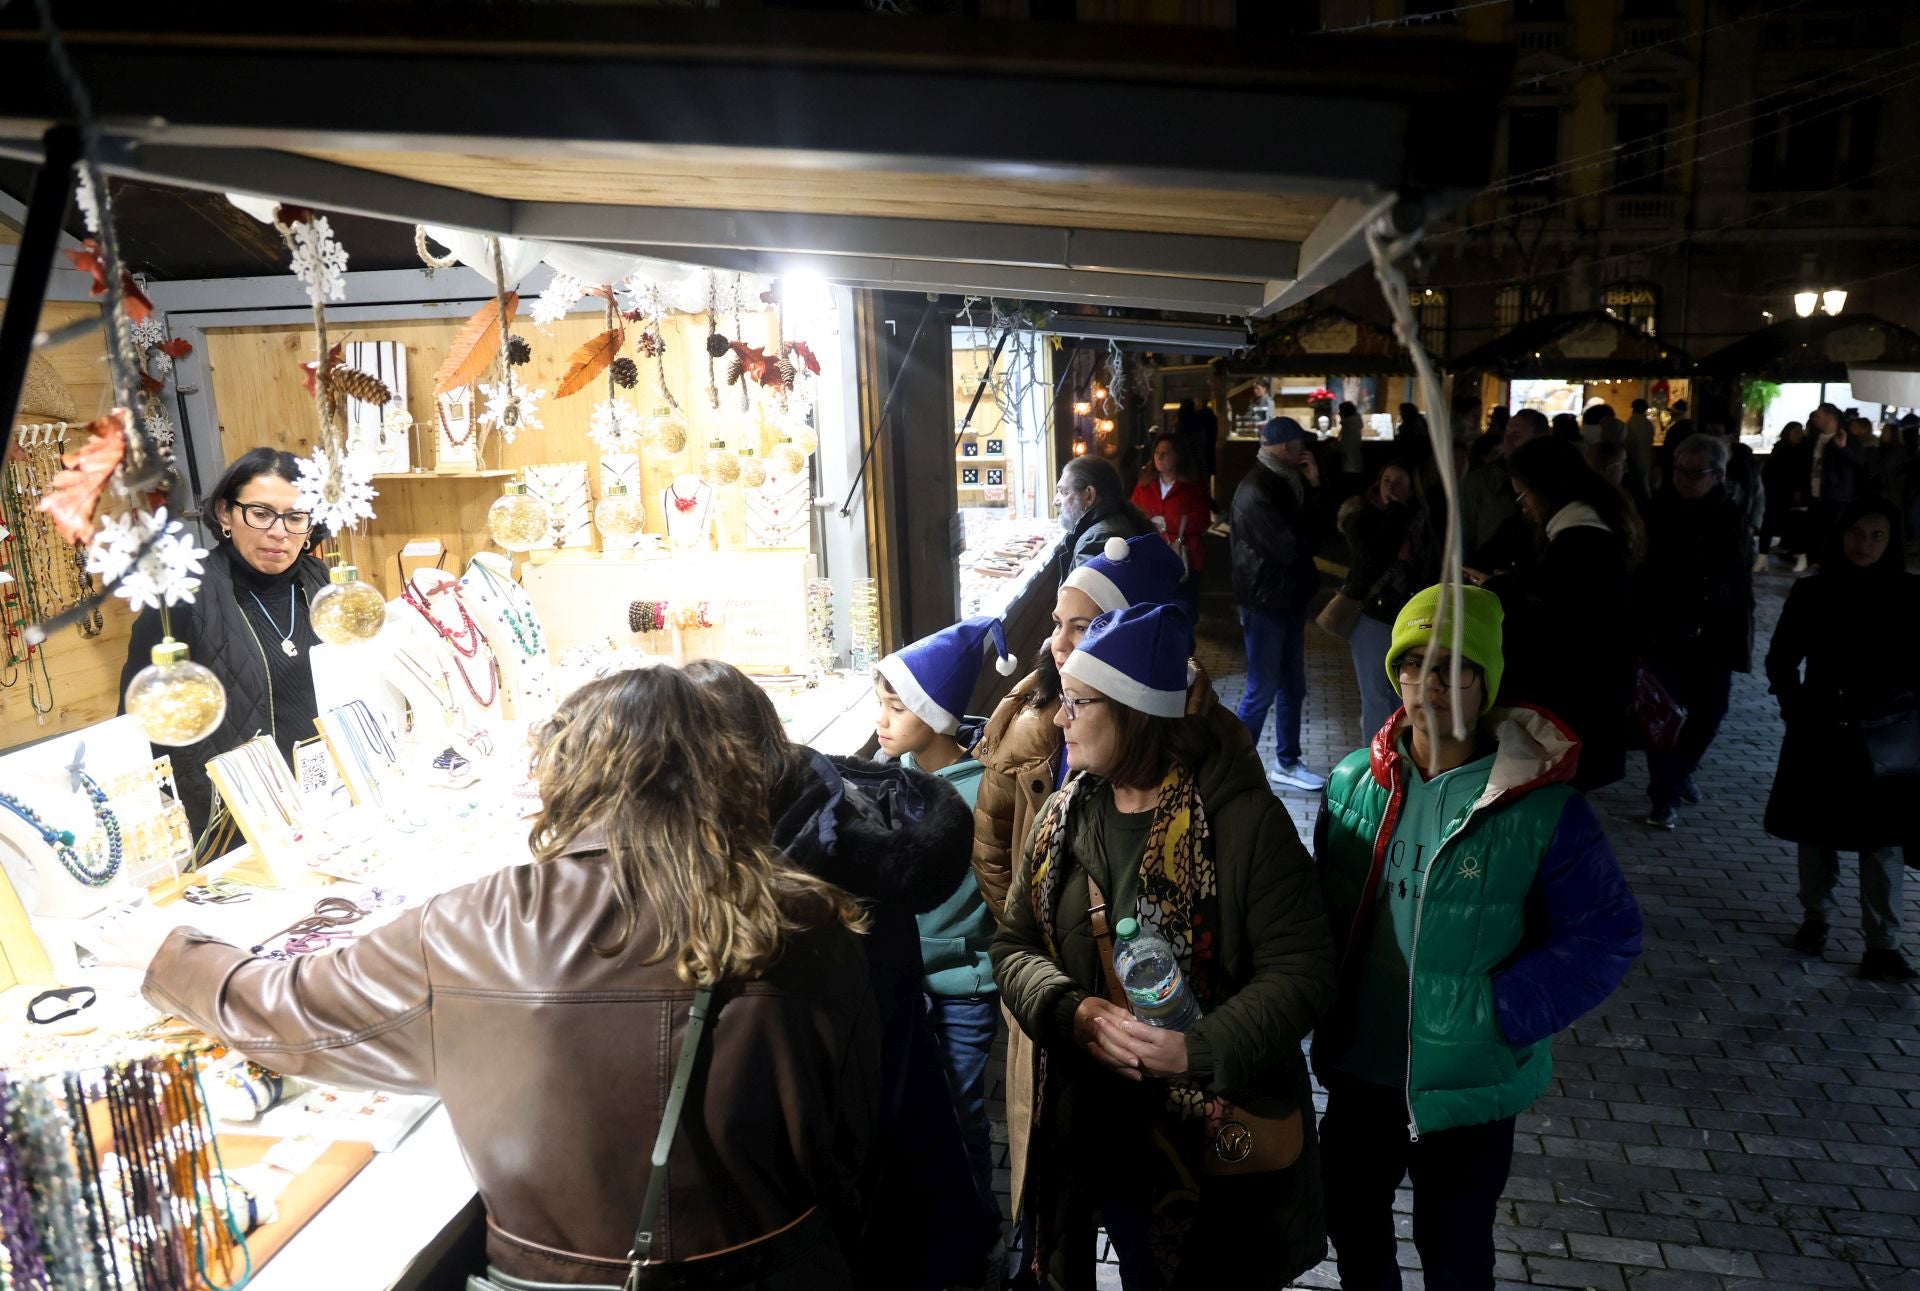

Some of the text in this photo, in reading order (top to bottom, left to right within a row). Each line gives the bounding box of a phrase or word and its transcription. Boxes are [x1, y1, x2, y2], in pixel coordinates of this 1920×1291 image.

[1409, 291, 1445, 306] BVA
[1606, 290, 1655, 306] BBVA
[1390, 840, 1426, 874] OL
